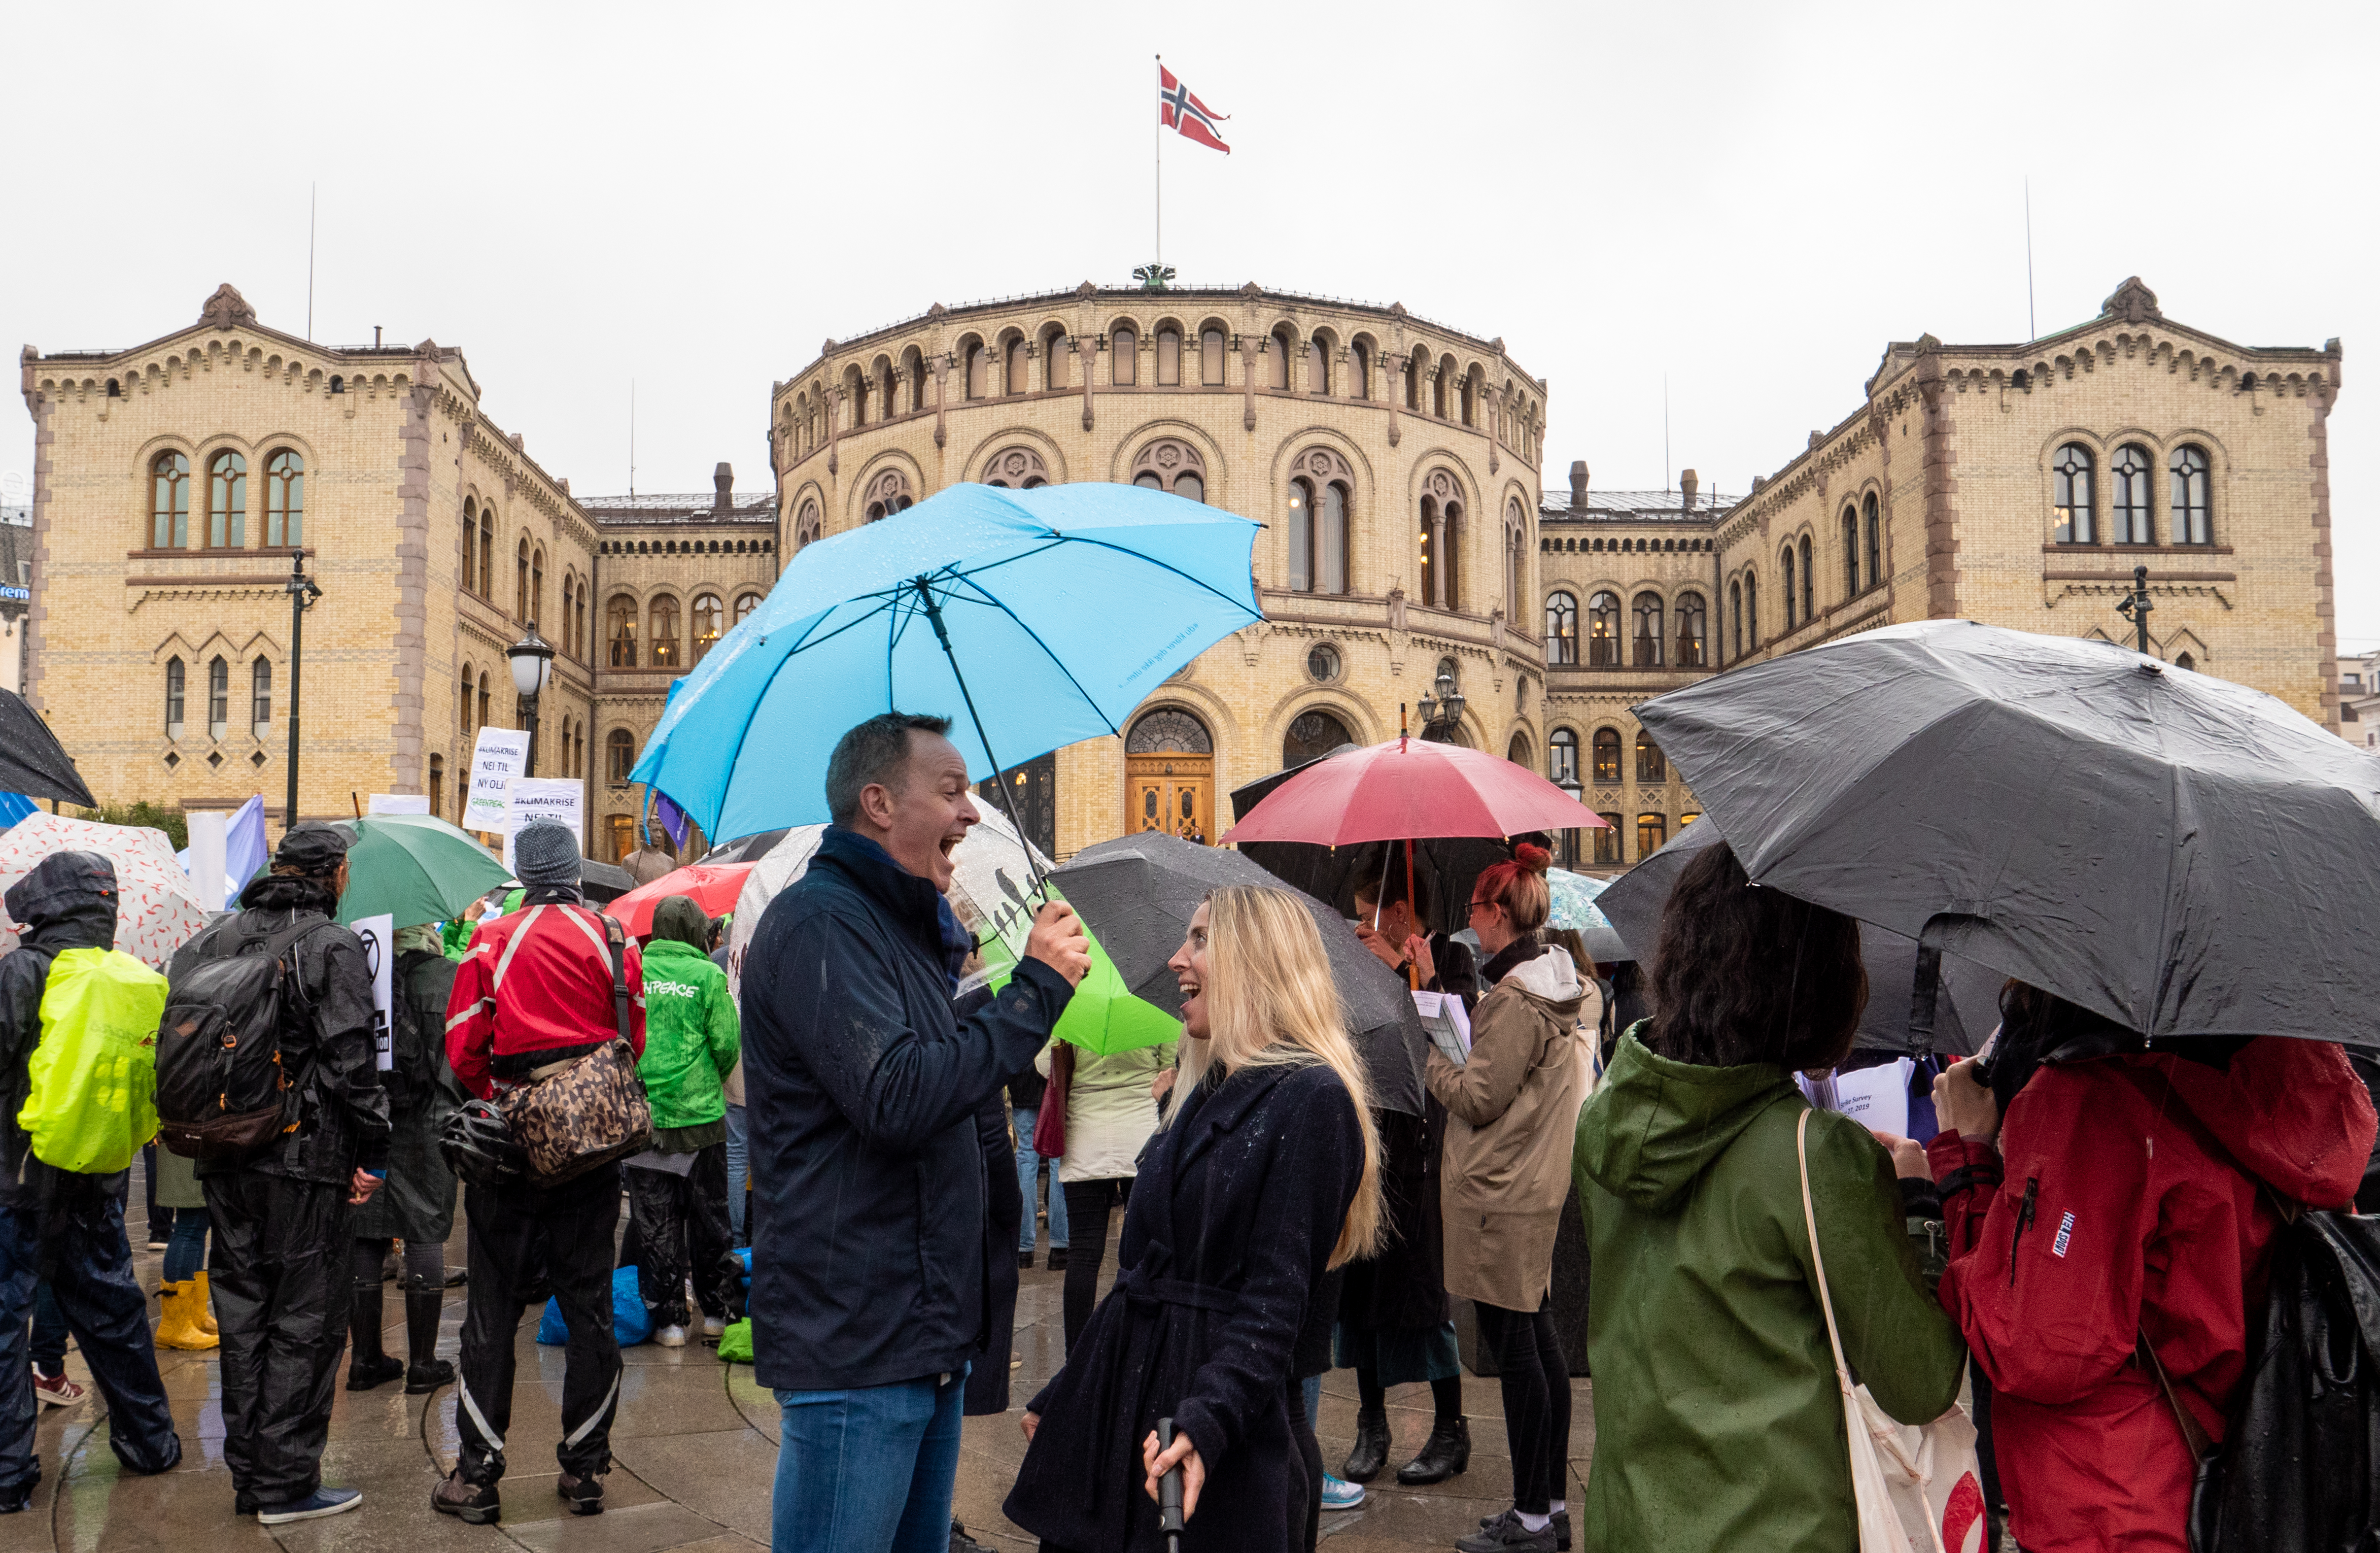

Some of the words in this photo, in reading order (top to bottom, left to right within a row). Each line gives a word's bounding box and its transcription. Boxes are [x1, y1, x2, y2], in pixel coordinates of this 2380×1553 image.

[478, 746, 519, 756] #KLIMAKRISE
[483, 761, 495, 770] NEI
[498, 762, 509, 771] TIL
[478, 779, 489, 788] NY
[490, 780, 505, 790] OLJ
[471, 797, 505, 808] GREENPEAC
[514, 797, 575, 806] #KLIMAKRISE
[643, 981, 699, 998] NPEACE
[1852, 1095, 1872, 1103] Survey
[1855, 1103, 1870, 1111] 2019
